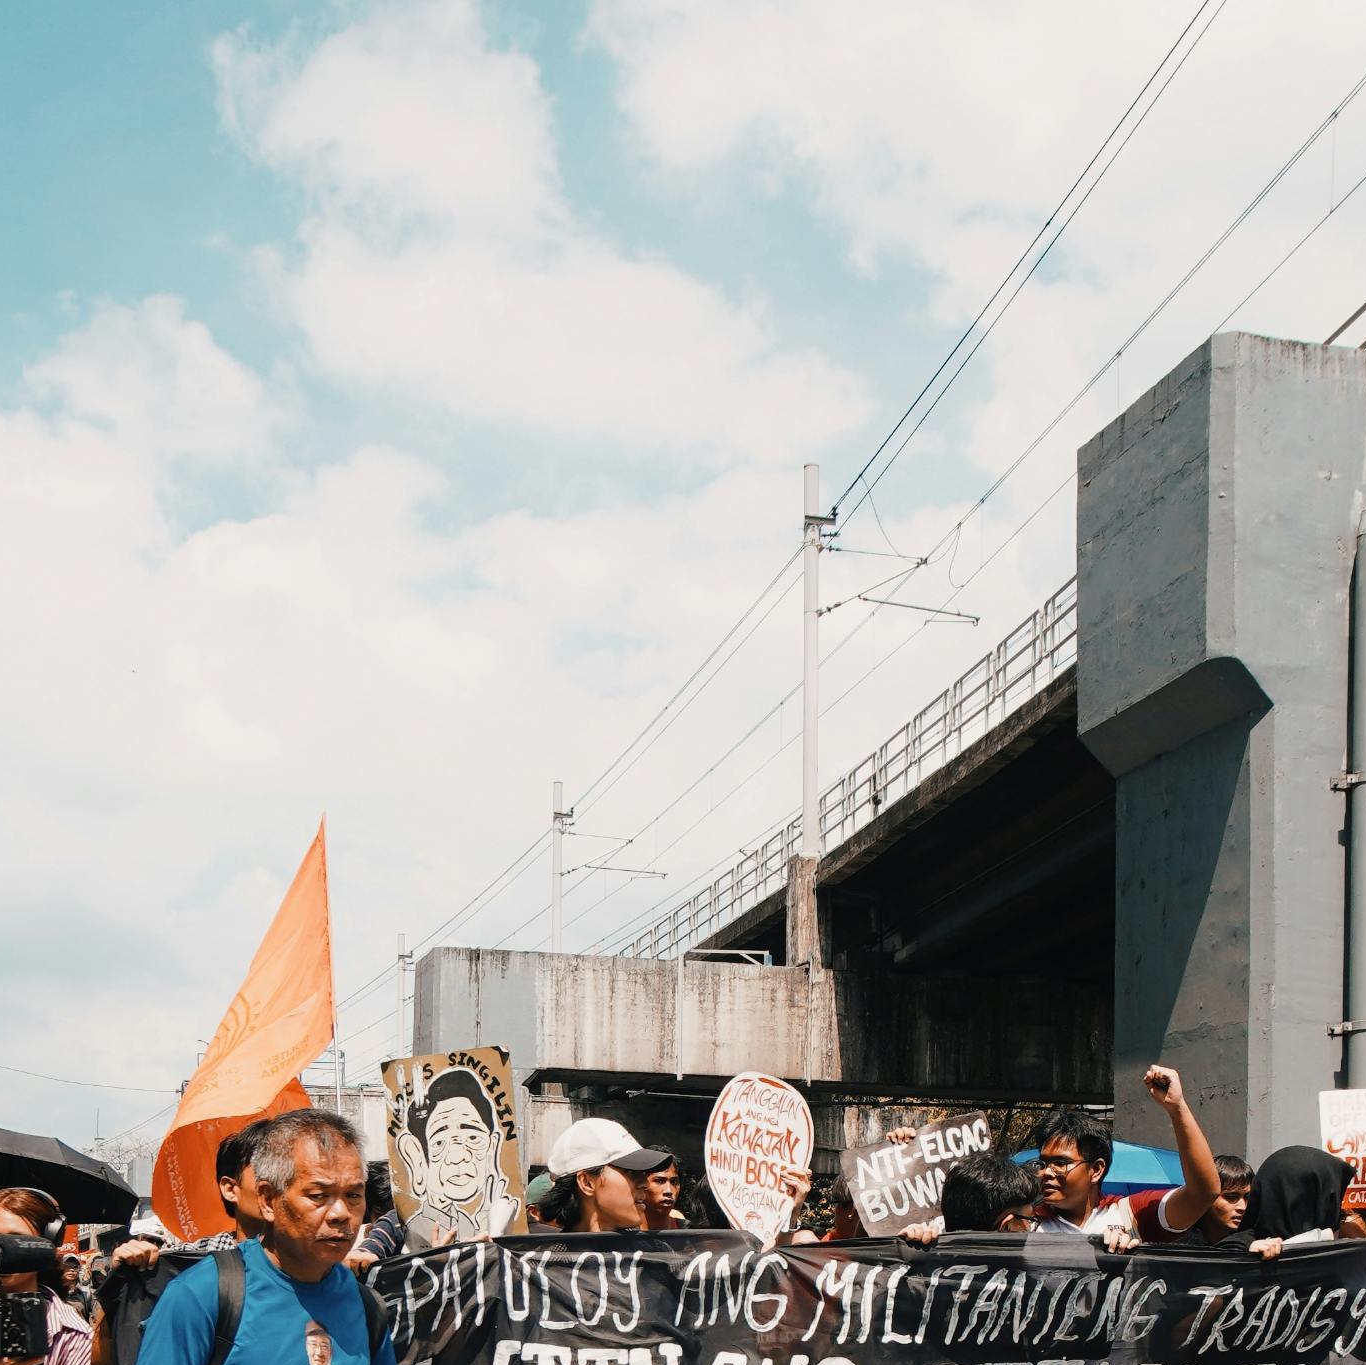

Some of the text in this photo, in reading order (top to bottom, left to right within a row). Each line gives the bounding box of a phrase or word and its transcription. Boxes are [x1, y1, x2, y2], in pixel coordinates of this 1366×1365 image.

[448, 1053, 517, 1141] SINGILIN
[733, 1078, 802, 1120] TANGGALIN
[746, 1110, 762, 1121] ANG
[717, 1111, 801, 1164] KAWATAN
[856, 1118, 991, 1189] NTF-ELCAC
[710, 1147, 795, 1197] HINDI BOSE
[859, 1162, 958, 1223] BUWA
[728, 1179, 786, 1219] KABATAAN!
[674, 1251, 789, 1332] ANG
[801, 1260, 1167, 1346] MILITANTENG
